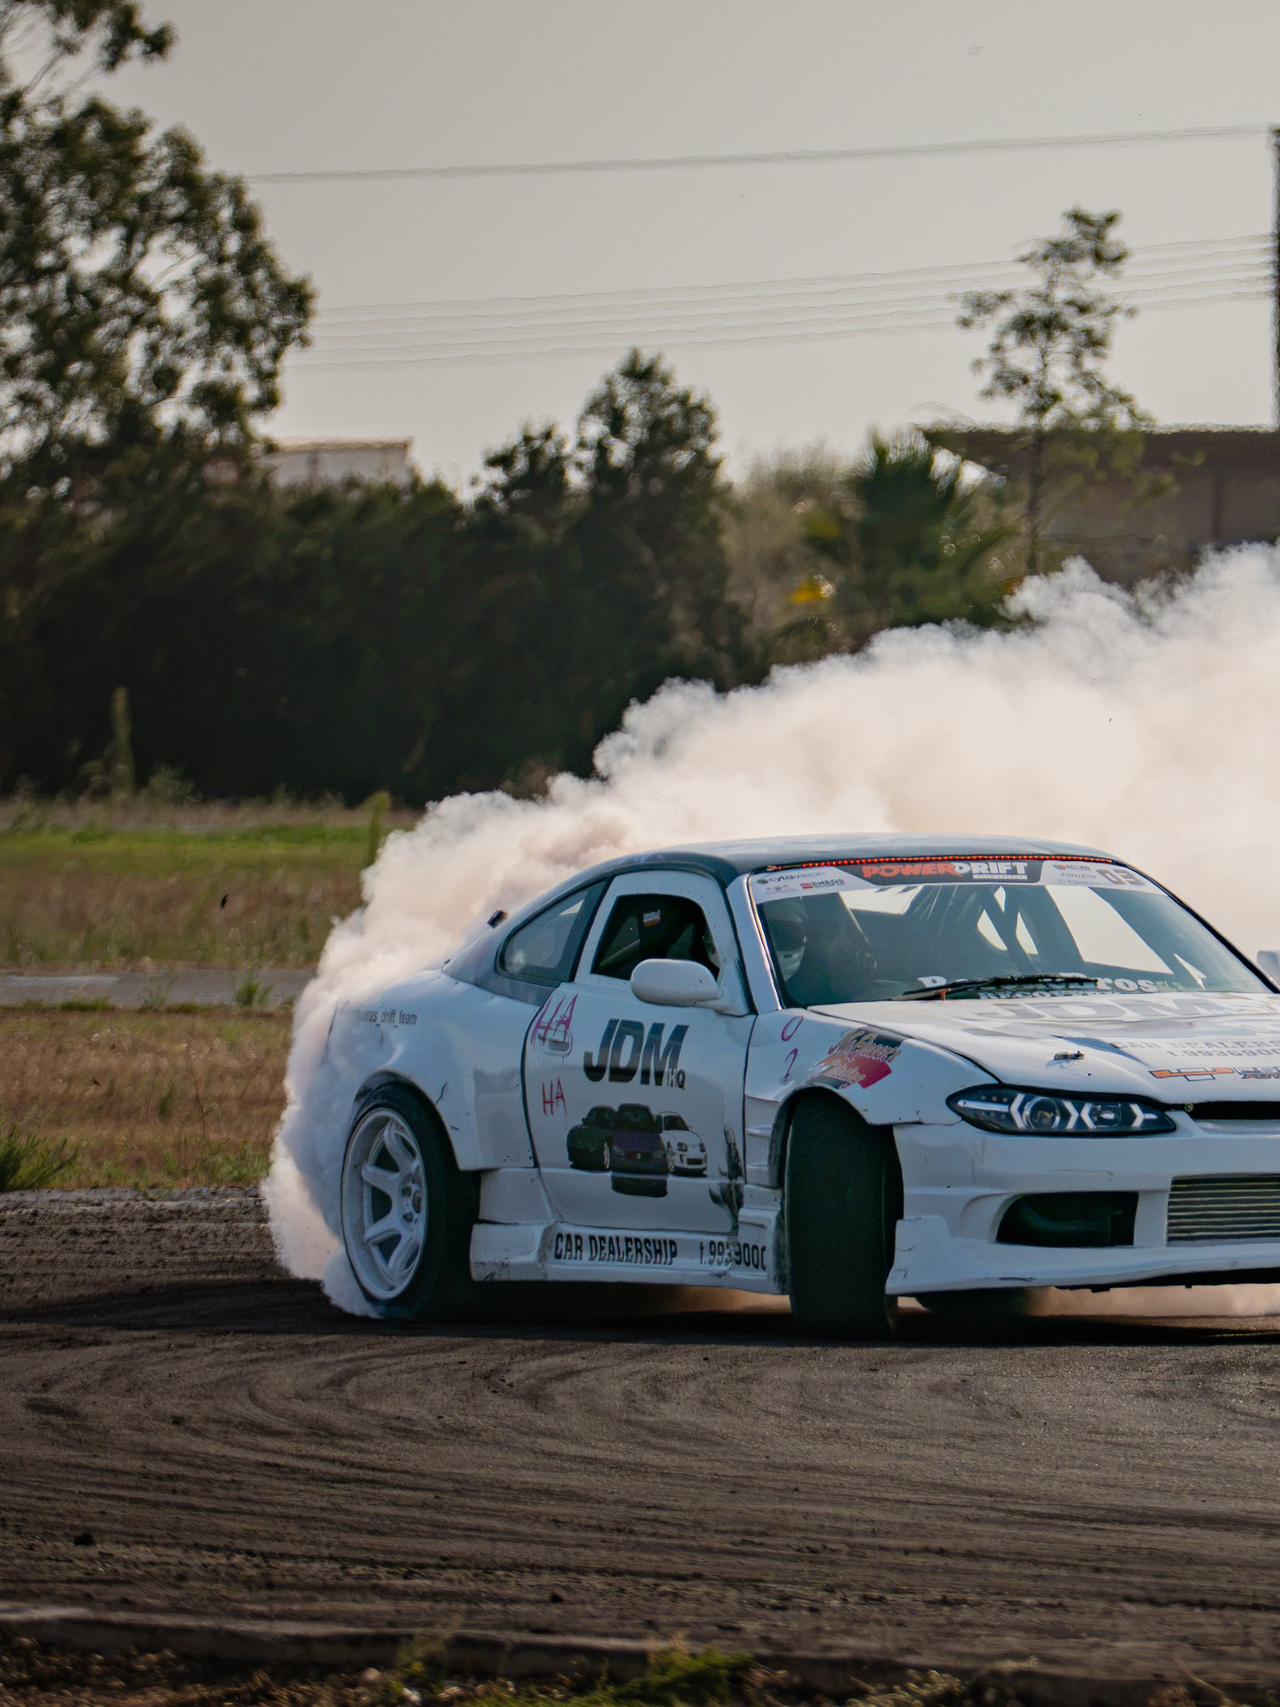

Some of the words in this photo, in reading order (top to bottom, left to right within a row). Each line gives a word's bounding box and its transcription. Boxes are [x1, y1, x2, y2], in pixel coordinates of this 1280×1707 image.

[974, 998, 1230, 1019] JDM
[583, 1018, 690, 1086] JDM
[1111, 1041, 1162, 1050] CAR
[667, 1067, 686, 1090] HQ
[542, 1077, 567, 1116] HA
[554, 1232, 583, 1261] CAR
[588, 1234, 678, 1266] DEALERSHIP
